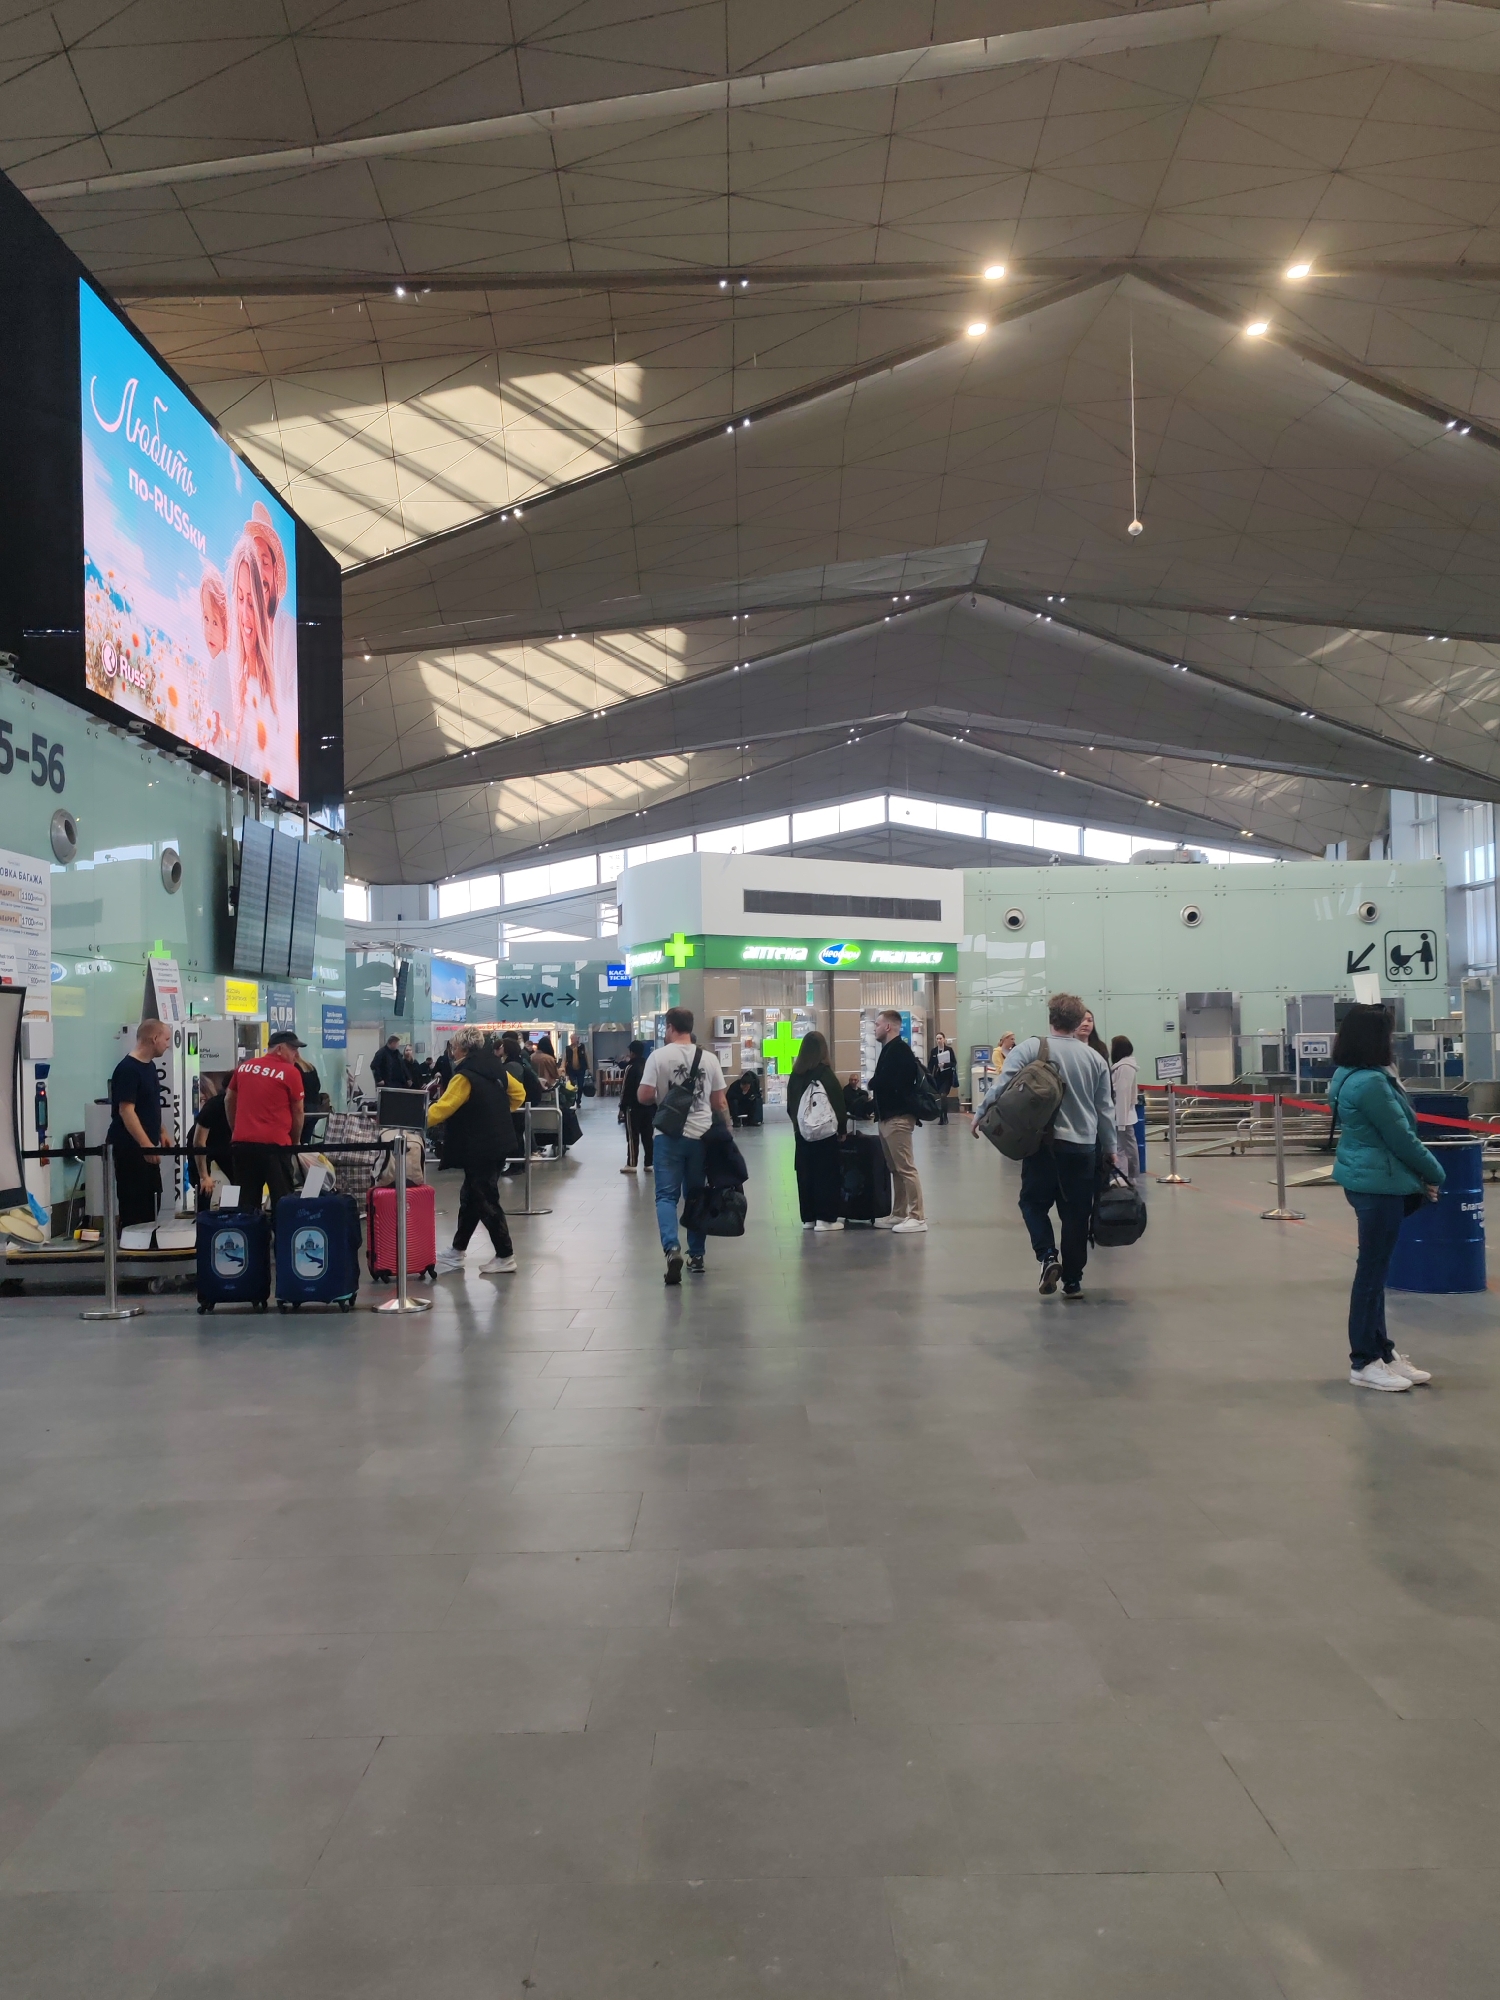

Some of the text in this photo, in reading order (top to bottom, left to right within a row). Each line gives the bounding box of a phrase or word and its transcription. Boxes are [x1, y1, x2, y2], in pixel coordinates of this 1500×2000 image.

[90, 375, 197, 498] Любить
[119, 654, 146, 690] Russ
[18, 871, 43, 885] БАГАЖА
[521, 992, 555, 1008] WC
[237, 1063, 284, 1081] RUSSIA
